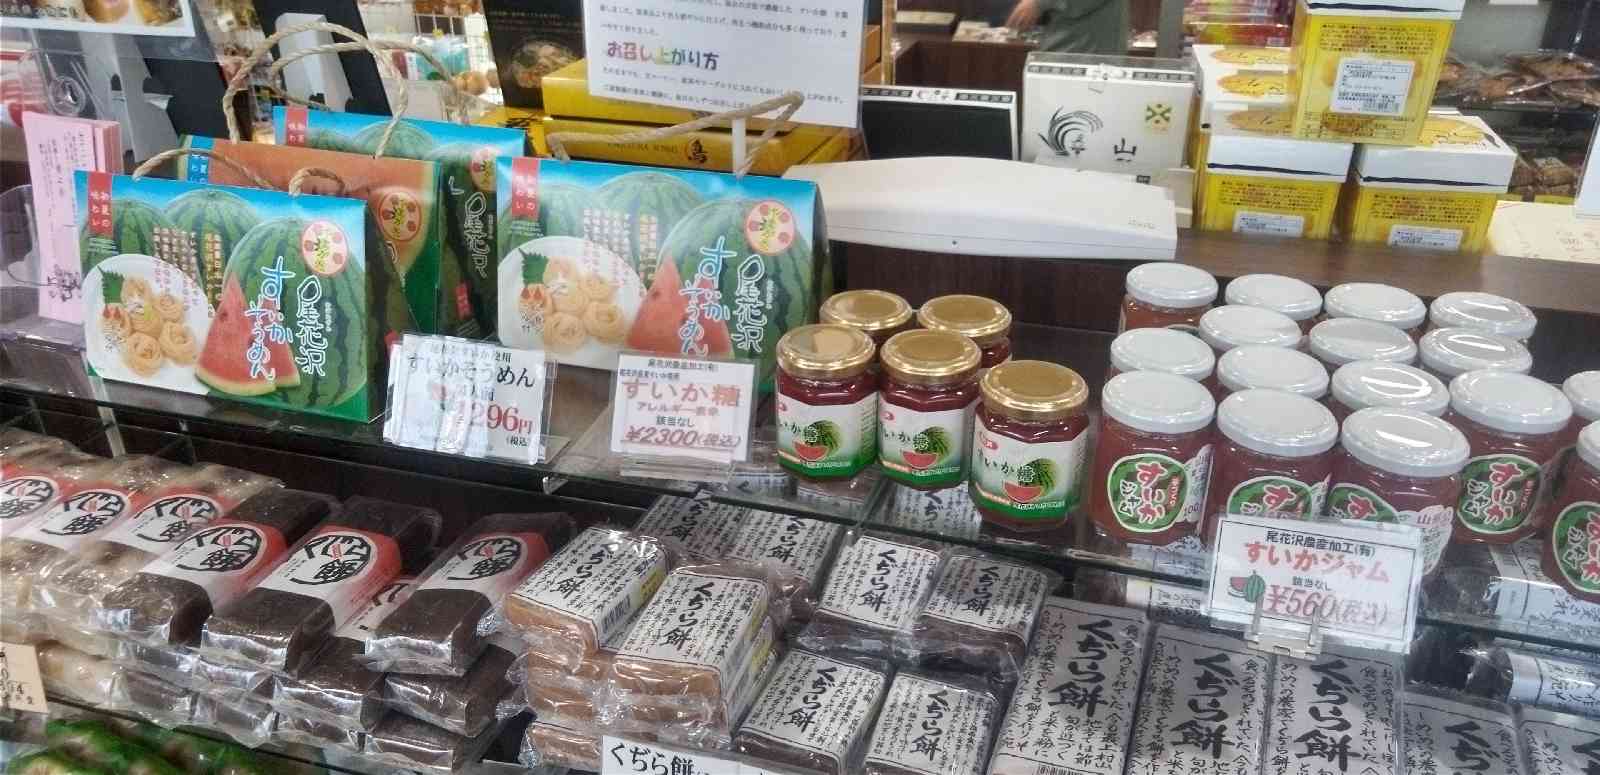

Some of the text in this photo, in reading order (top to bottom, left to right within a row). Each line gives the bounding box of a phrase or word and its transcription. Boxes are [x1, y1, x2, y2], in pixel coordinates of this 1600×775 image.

[607, 41, 719, 70] お召し上がり方
[258, 255, 297, 345] すいか
[694, 234, 738, 322] すいか
[244, 300, 276, 381] そうめん
[679, 279, 709, 356] そうめん
[621, 378, 741, 408] すいか糖
[656, 416, 696, 428] 該当なし
[1119, 479, 1141, 517] ジャム
[1136, 461, 1168, 524] すいか
[1464, 479, 1490, 518] ジャム
[1484, 461, 1523, 526] すいか
[1244, 541, 1391, 583] すいかジャム
[1265, 529, 1376, 557] 尾花沢農産加工(有)
[860, 549, 898, 612] くぢら餅
[1292, 576, 1334, 591] 該当なし
[659, 581, 715, 651] くぢら餅
[784, 666, 838, 733] くぢら餅
[1047, 619, 1119, 718] くぢら餅
[909, 689, 952, 761] くぢら餅
[1169, 652, 1240, 760] くぢら餅
[1293, 659, 1362, 773] くぢら餅
